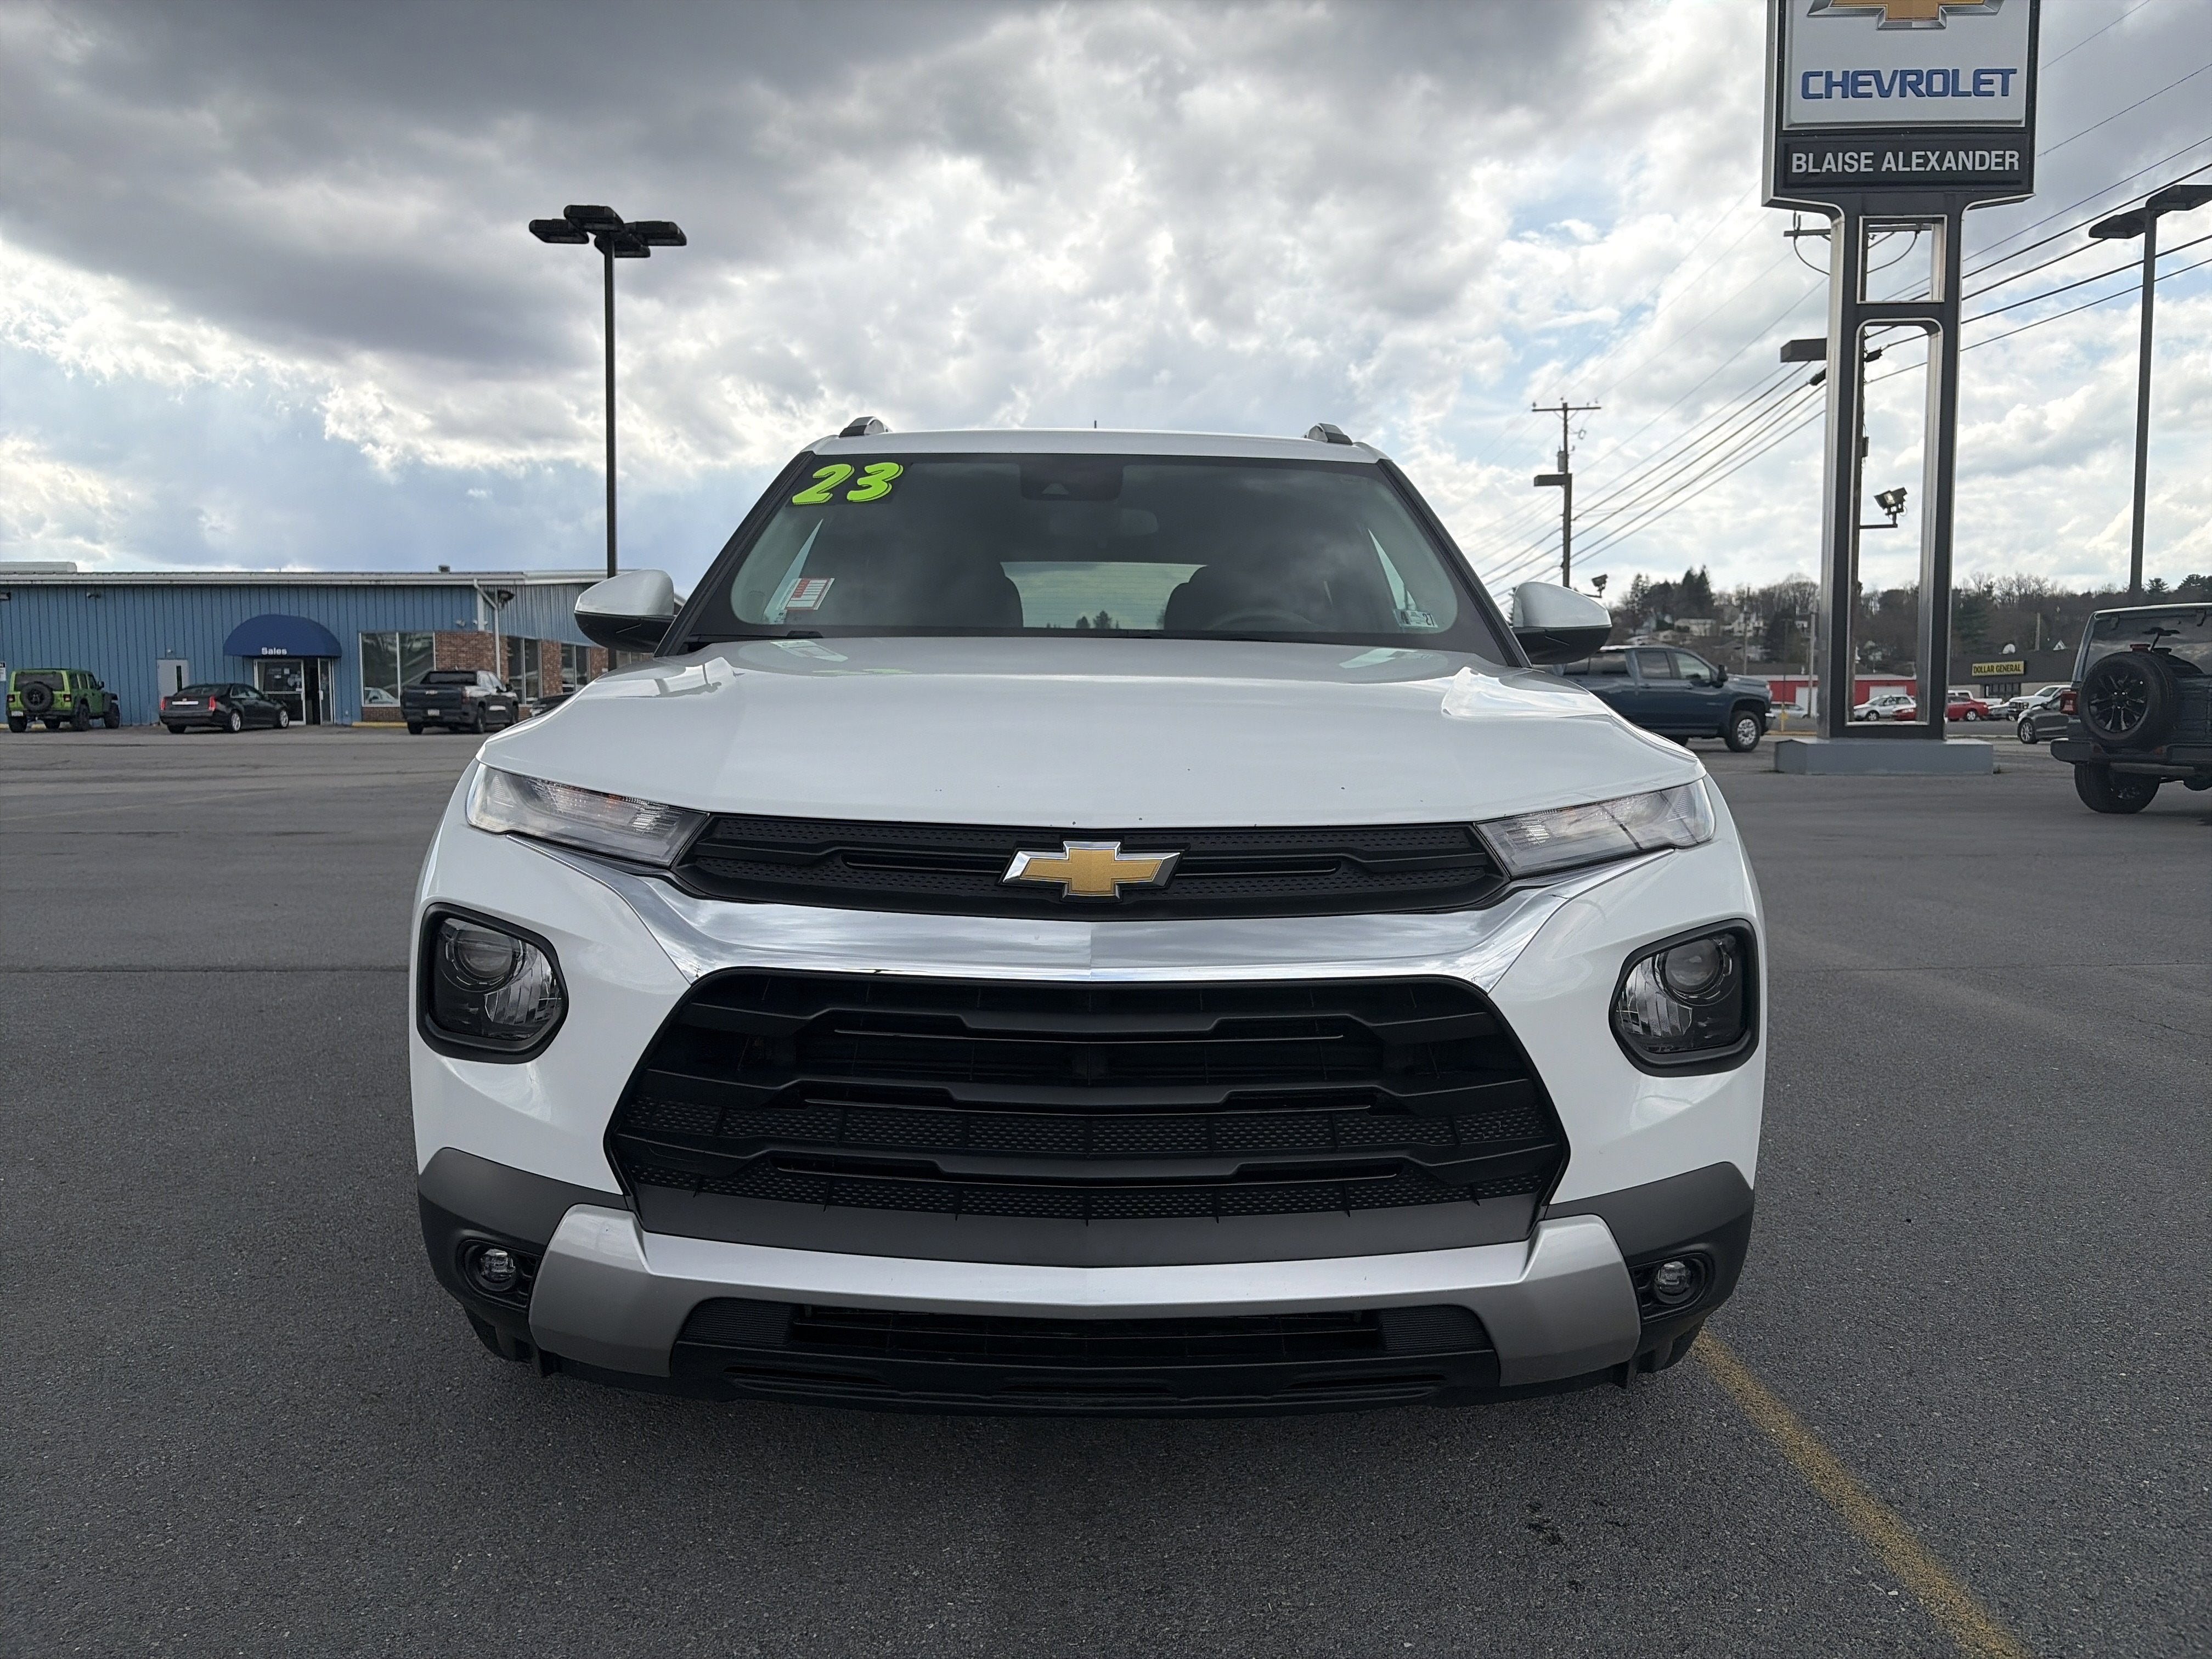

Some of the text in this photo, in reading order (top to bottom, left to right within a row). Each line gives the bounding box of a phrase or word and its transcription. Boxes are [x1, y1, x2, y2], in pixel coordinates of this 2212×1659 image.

[1801, 68, 2017, 99] CHEVROLET
[1792, 150, 2019, 173] BLAISE ALEXANDER
[792, 462, 904, 505] 23
[1422, 613, 1435, 626] 27
[1973, 663, 2021, 673] DOLLAR GENERAL
